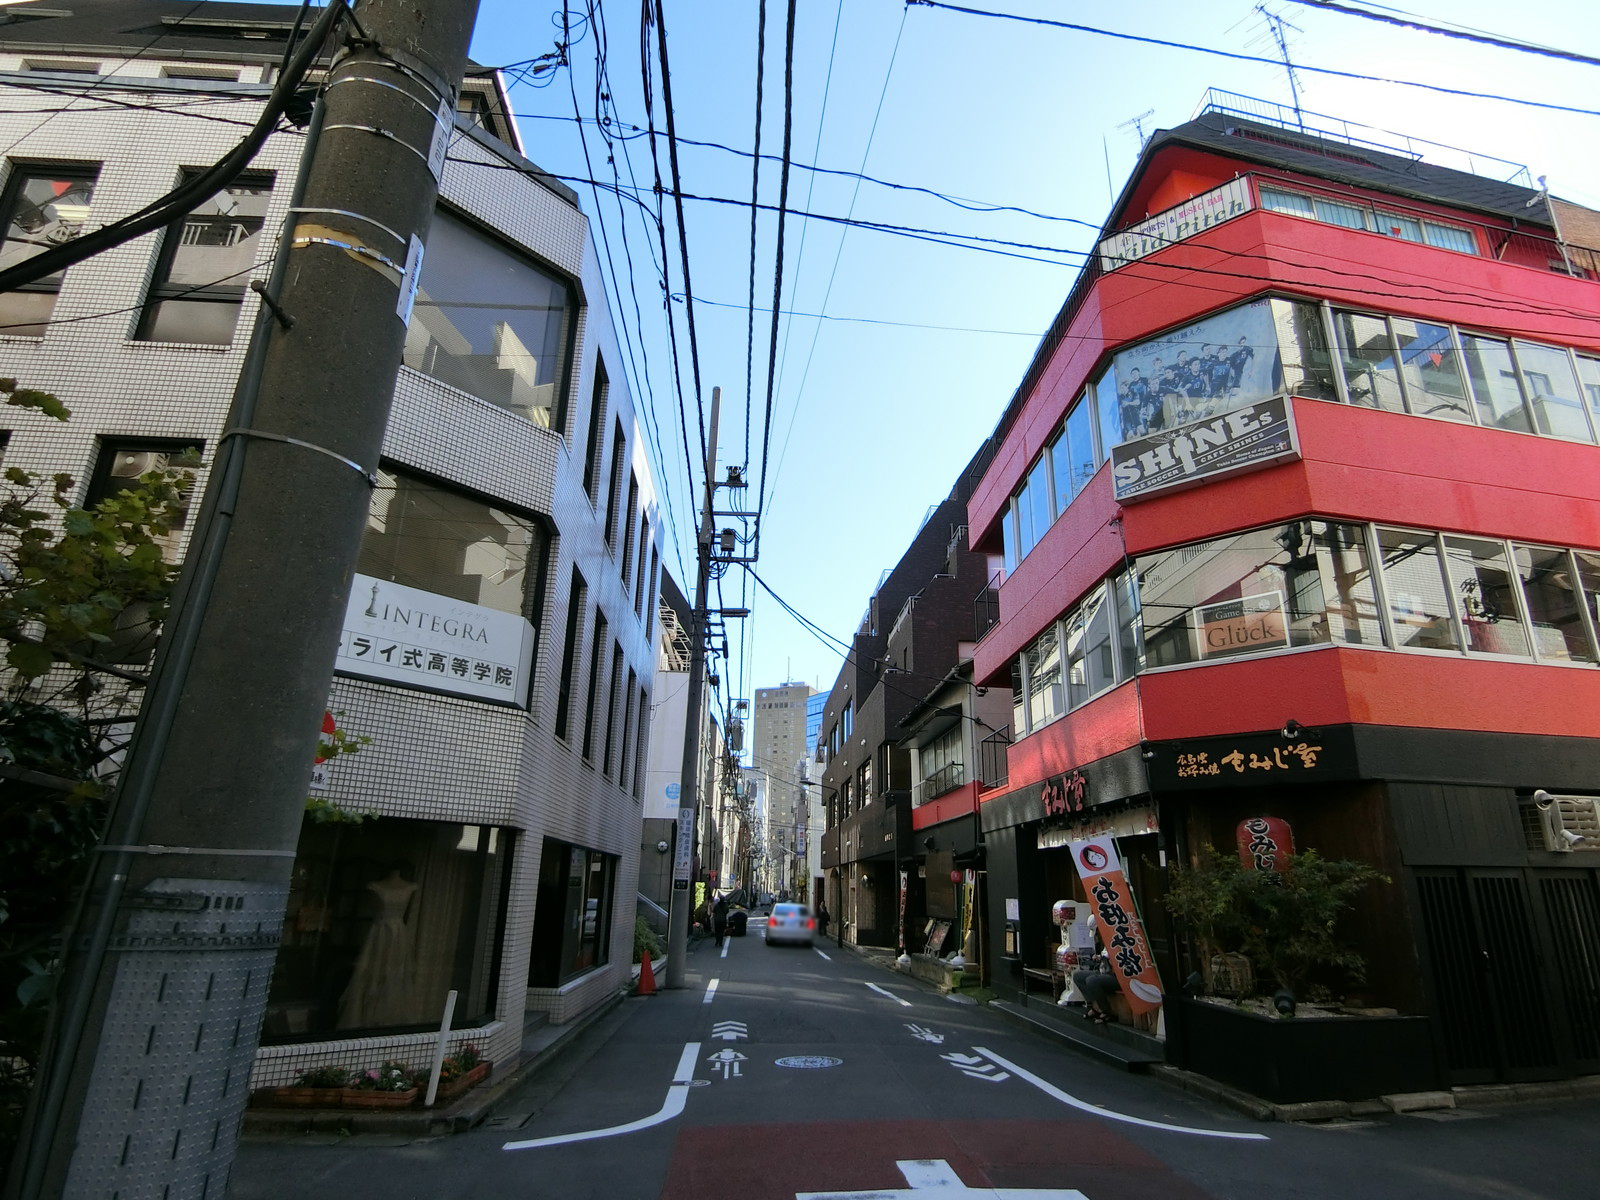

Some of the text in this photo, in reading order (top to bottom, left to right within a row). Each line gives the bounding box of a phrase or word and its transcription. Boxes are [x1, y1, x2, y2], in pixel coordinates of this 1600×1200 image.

[1178, 202, 1204, 219] MUSIC
[1206, 194, 1223, 207] BAR
[1107, 199, 1244, 269] Wild Pitch
[1200, 432, 1265, 464] CAFE SHINES
[1119, 469, 1179, 497] TABLE SOCCER
[383, 603, 489, 645] INTEGRA
[1215, 608, 1240, 620] Game
[1206, 618, 1277, 648] Glück
[338, 636, 514, 688] ライ式高等学院
[1220, 742, 1323, 774] もみじ屋
[1041, 769, 1087, 817] もみじ屋
